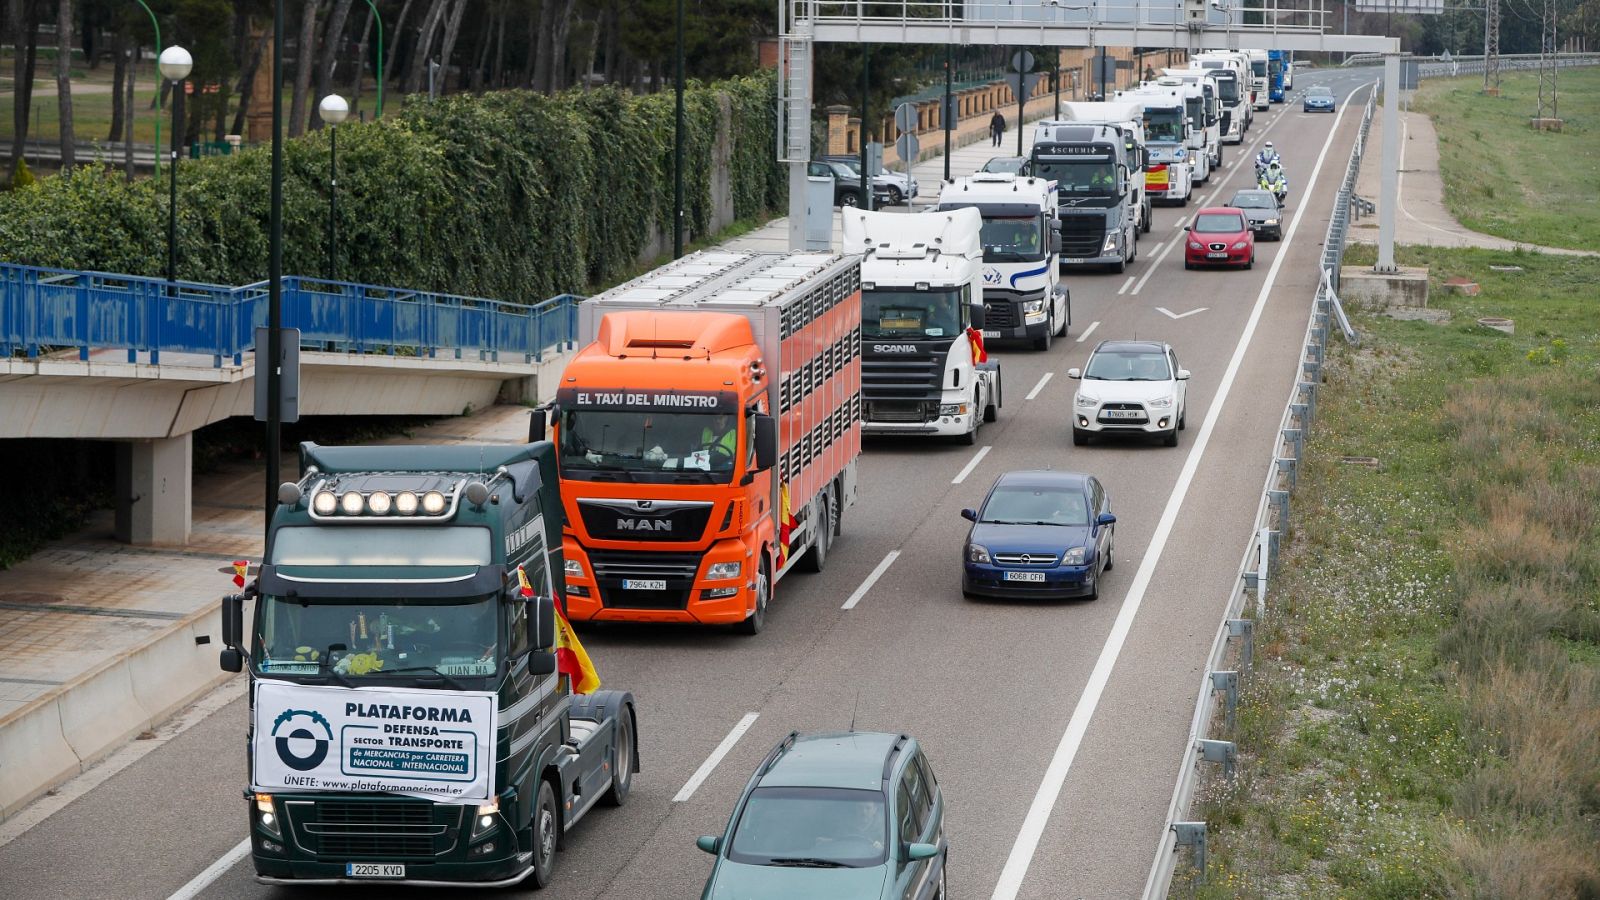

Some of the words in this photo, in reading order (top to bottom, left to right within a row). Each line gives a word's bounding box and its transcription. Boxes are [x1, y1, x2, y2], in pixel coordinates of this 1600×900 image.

[873, 344, 917, 353] SCANIA
[577, 392, 593, 405] EL
[595, 393, 623, 405] TAXI
[626, 393, 651, 406] DEL
[653, 394, 718, 408] MINISTRO
[617, 519, 672, 531] MAN
[1010, 572, 1027, 580] 6068
[1030, 573, 1043, 581] CFR
[629, 580, 647, 589] 7964
[650, 580, 664, 589] KZH
[345, 702, 473, 723] PLATAFORMA
[384, 723, 439, 736] DEFENSA
[353, 737, 384, 746] SECTOR
[388, 736, 464, 750] TRANSPORTE
[353, 749, 363, 757] de
[364, 750, 410, 759] MERCANCIAS
[426, 754, 465, 762] CARRETERA
[353, 759, 394, 768] NACIONAL
[401, 761, 465, 772] INTERNACIONAL
[284, 774, 320, 787] ÚNETE:
[322, 780, 463, 794] www.plataformanacional.es
[355, 864, 380, 875] 2205
[383, 865, 403, 876] KVD
